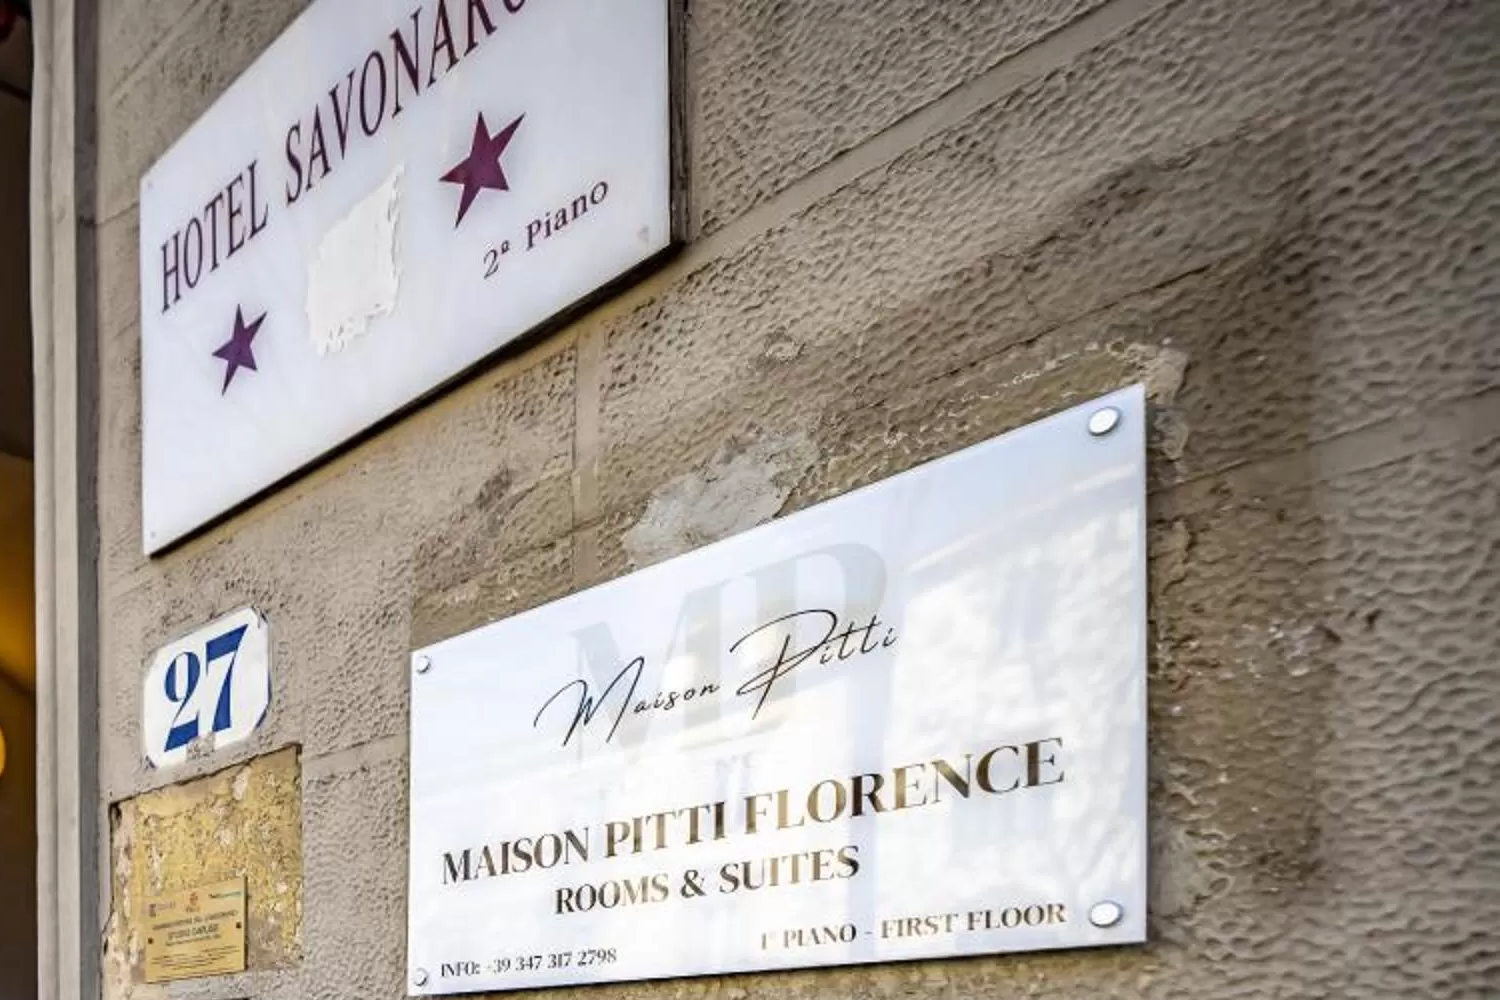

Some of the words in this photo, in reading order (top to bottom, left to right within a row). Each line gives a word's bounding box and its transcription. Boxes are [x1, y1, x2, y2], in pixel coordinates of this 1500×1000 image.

[159, 159, 268, 314] HOTEL
[284, 0, 525, 207] SAVONAR
[525, 181, 608, 251] Piano
[164, 624, 249, 752] 27
[533, 656, 720, 747] Maison
[729, 608, 899, 720] Pitti
[442, 827, 590, 885] MAISON
[602, 801, 726, 859] PITTI
[744, 737, 1066, 836] FLORENCE
[555, 872, 670, 914] ROOMS
[679, 868, 707, 899] &
[718, 845, 860, 894] SUITES
[783, 922, 858, 948] PIANO
[880, 912, 960, 939] FIRST
[967, 903, 1068, 931] FLOOR
[440, 960, 482, 978] INFO:
[515, 954, 543, 972] 347
[547, 951, 573, 969] 317
[577, 947, 618, 968] 2798
